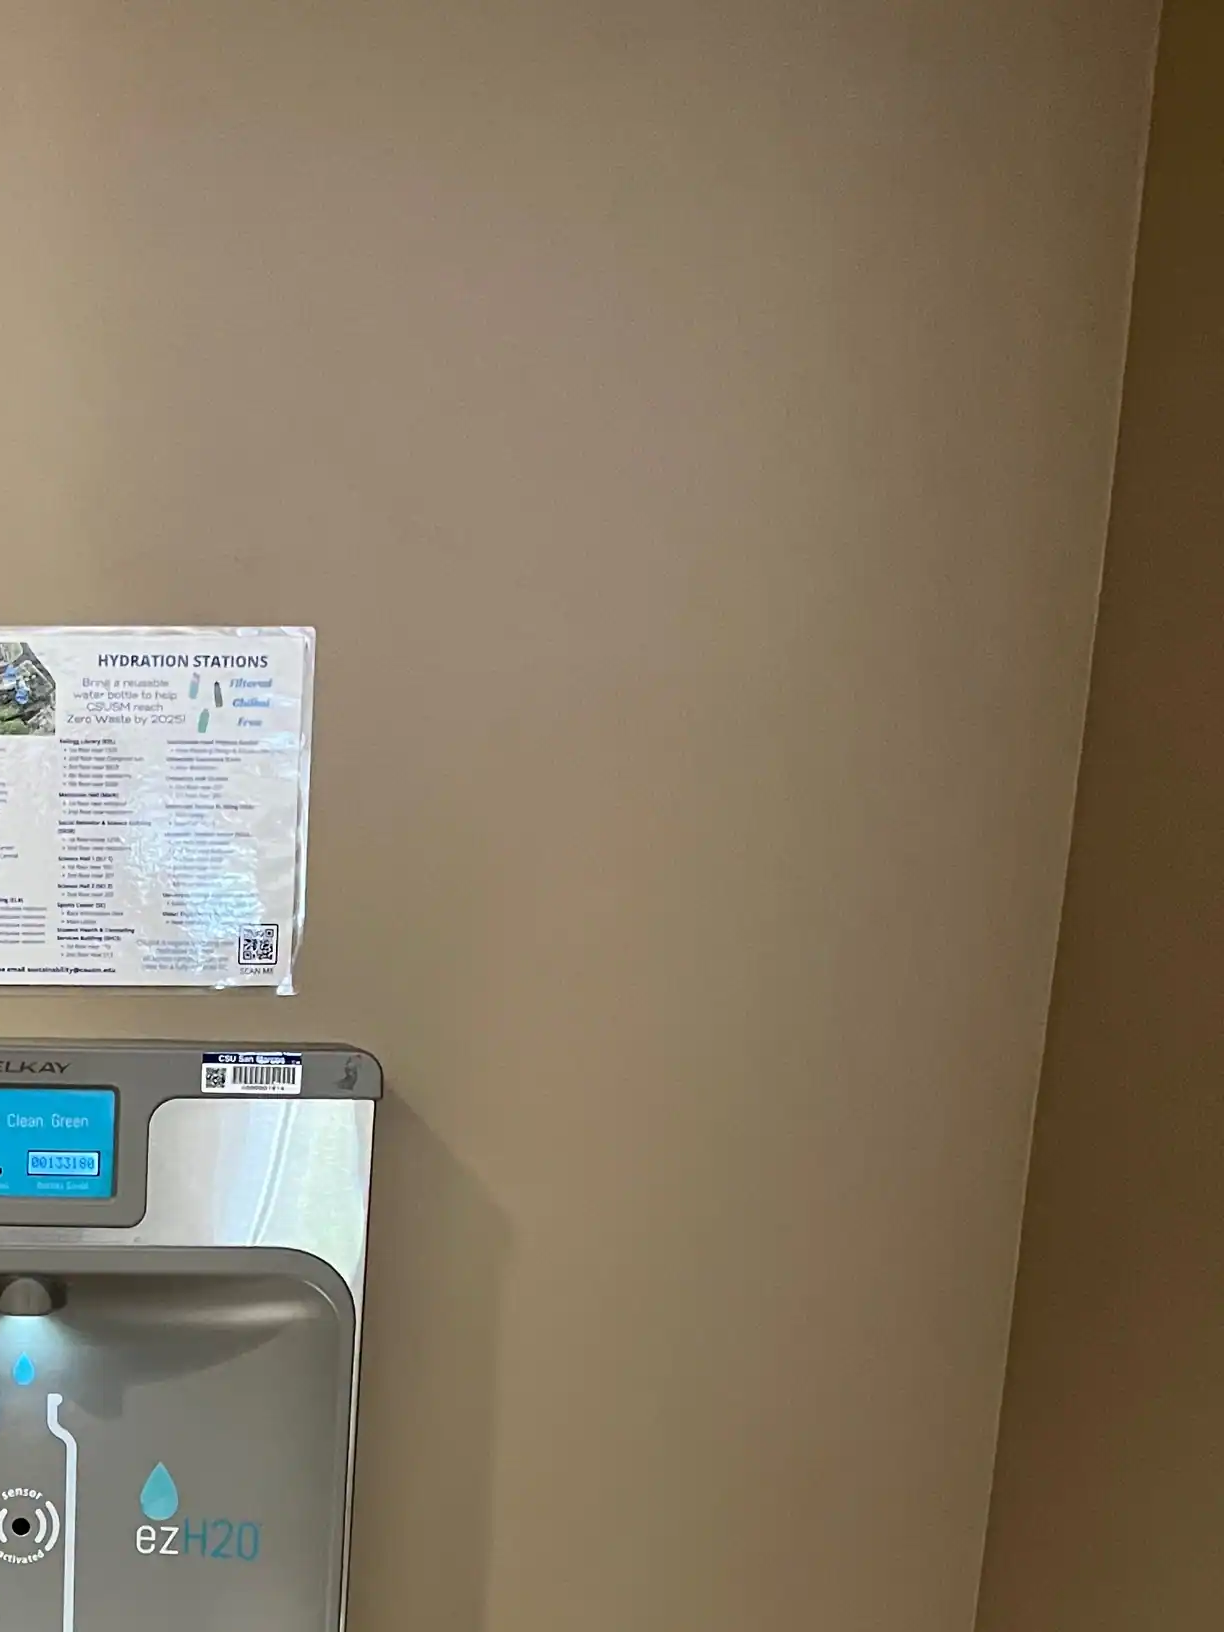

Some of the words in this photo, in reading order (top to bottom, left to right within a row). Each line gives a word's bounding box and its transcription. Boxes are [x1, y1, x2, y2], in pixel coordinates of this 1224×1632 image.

[98, 654, 188, 668] HYDRATION
[193, 655, 268, 668] STATIONS
[82, 677, 110, 690] Bring
[123, 678, 169, 687] reusable
[107, 691, 139, 699] bottle
[141, 691, 152, 699] to
[155, 691, 177, 701] help
[86, 702, 130, 712] CSUSM
[133, 703, 163, 712] reach
[67, 715, 92, 724] Zero
[95, 715, 131, 724] Waste
[135, 715, 147, 726] by
[151, 715, 186, 724] 2025!
[218, 1055, 236, 1063] CSU
[238, 1055, 254, 1063] San
[7, 1113, 44, 1128] Clean
[51, 1113, 89, 1128] Green
[1, 1488, 43, 1500] sensor
